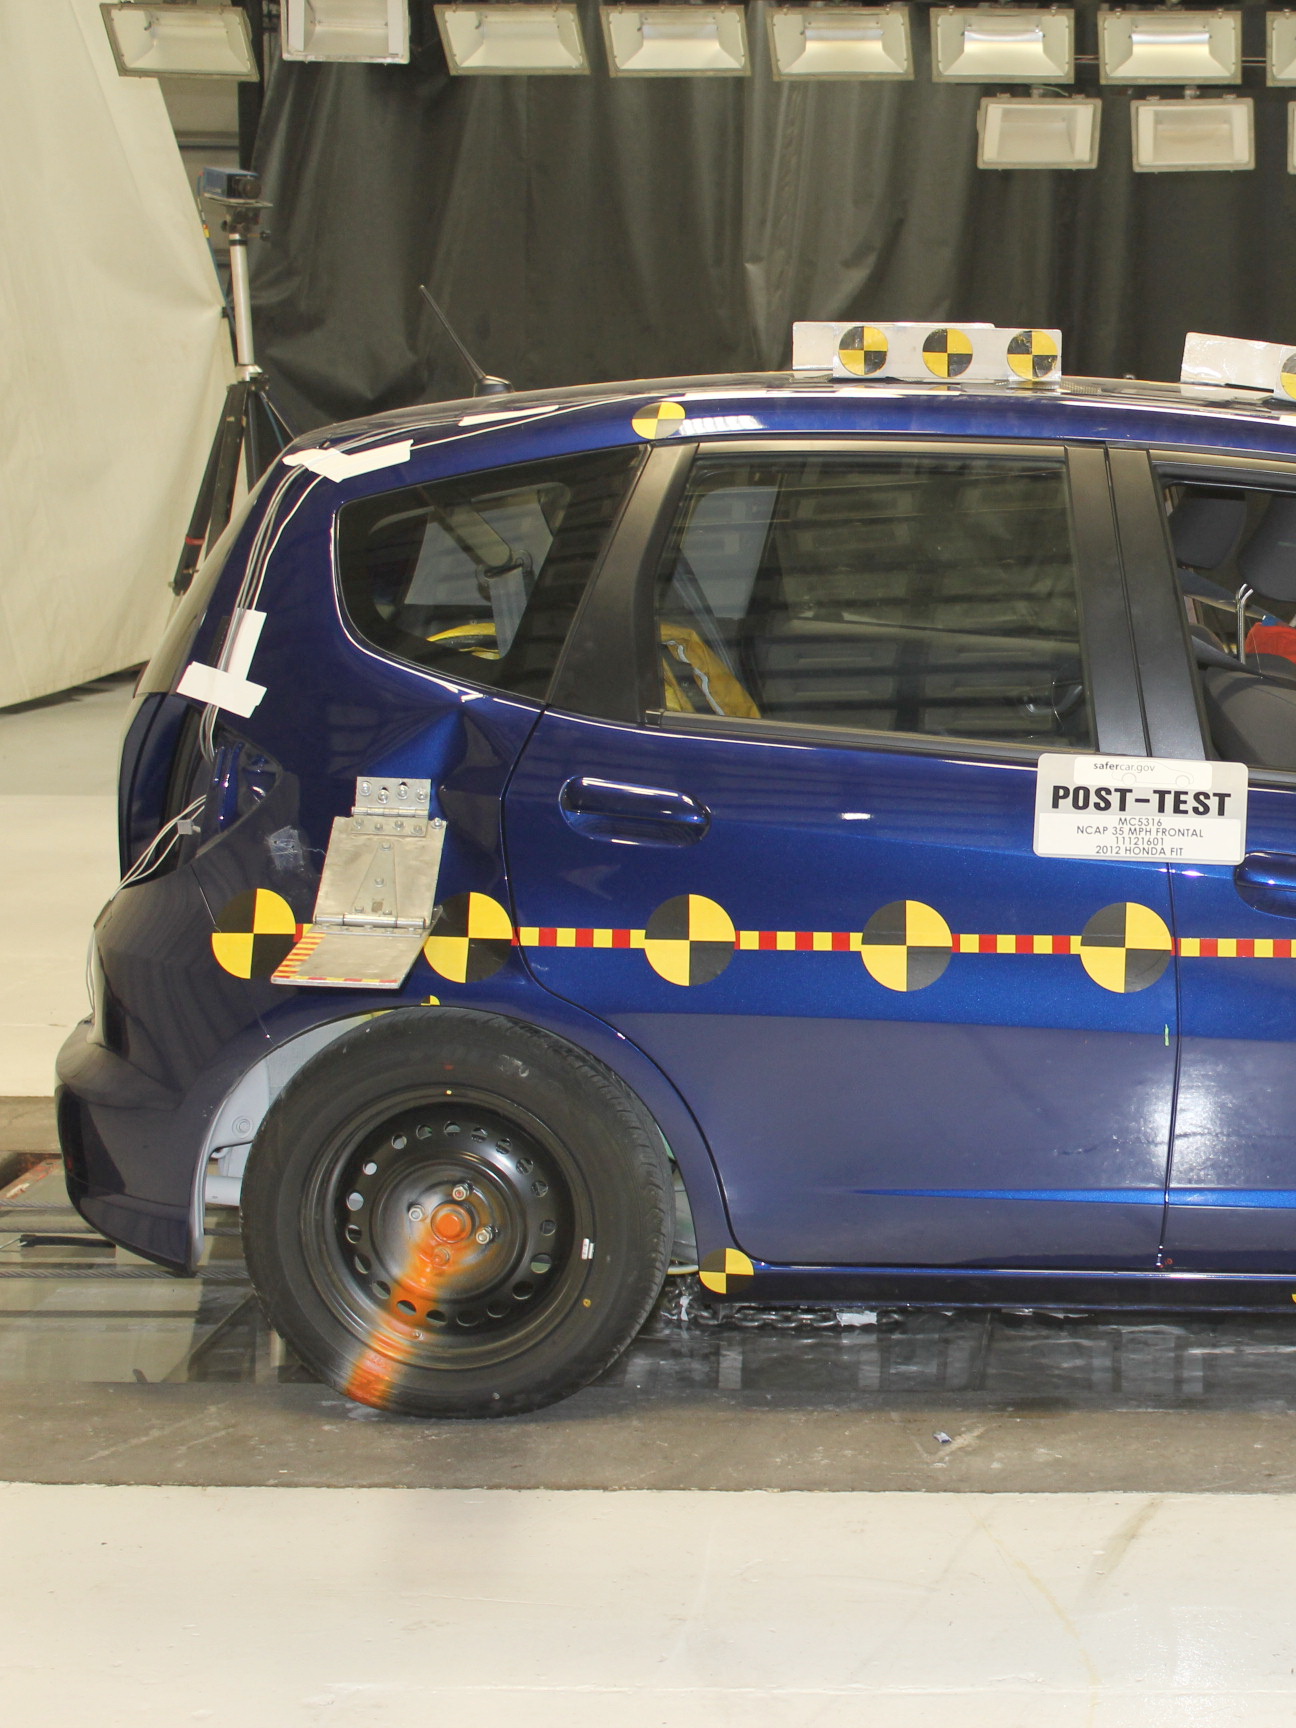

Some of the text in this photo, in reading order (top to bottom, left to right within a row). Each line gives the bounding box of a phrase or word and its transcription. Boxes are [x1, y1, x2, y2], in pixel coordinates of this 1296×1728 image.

[1093, 760, 1156, 773] safercar.gov
[1051, 785, 1232, 816] POST-TEST
[1118, 817, 1163, 827] MC5316
[1076, 826, 1204, 838] NCAP 35 MPH FRONTAL
[1115, 836, 1165, 846] 11121601
[1095, 845, 1184, 857] 2012 HONDA FIT
